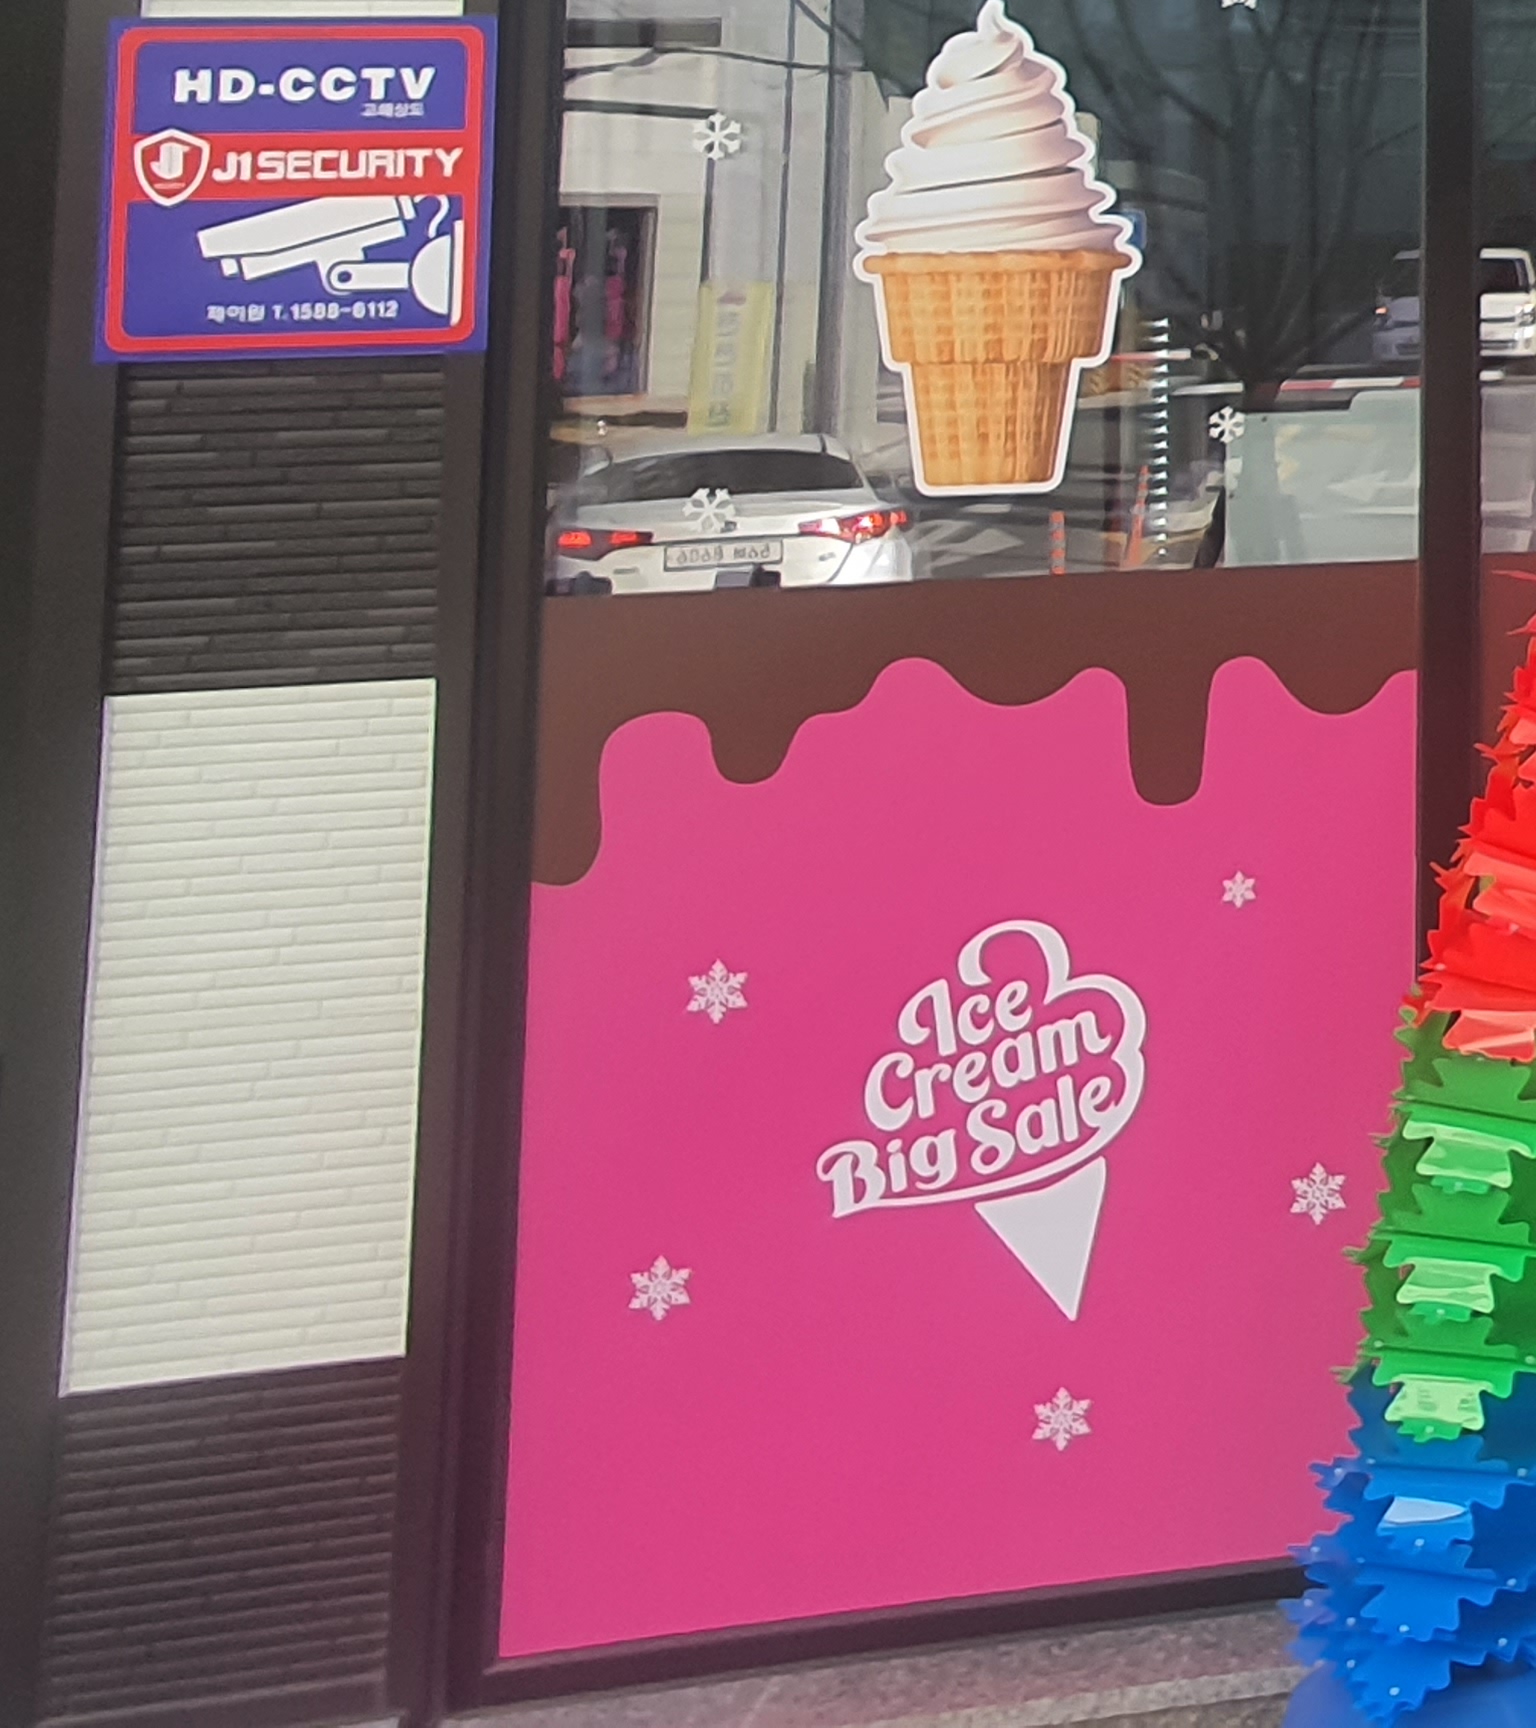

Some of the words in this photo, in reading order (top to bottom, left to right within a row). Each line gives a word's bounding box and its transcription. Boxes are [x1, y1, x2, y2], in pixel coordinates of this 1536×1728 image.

[173, 67, 436, 104] HD-CCTV
[898, 978, 1032, 1057] Ice
[864, 1010, 1112, 1131] Cream
[816, 1128, 957, 1219] Big
[966, 1075, 1117, 1175] Sale
